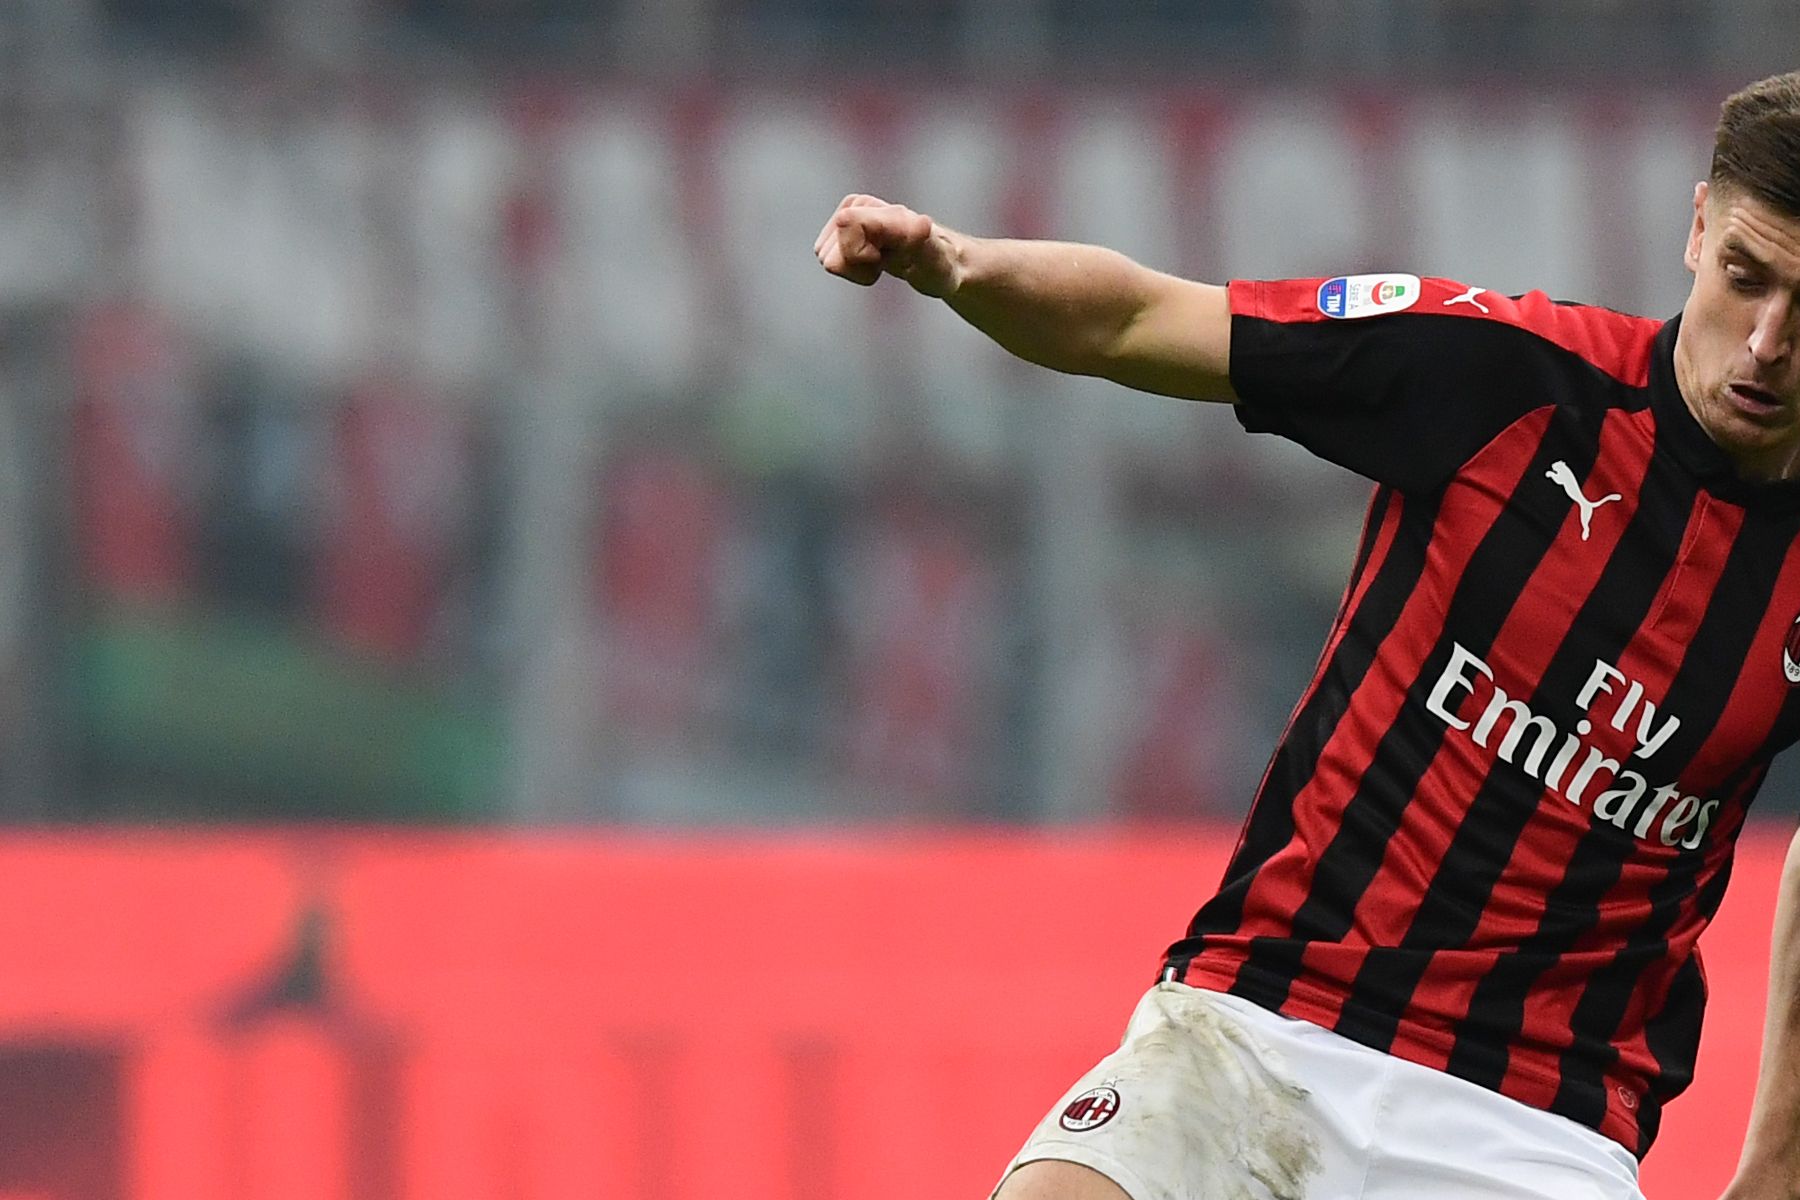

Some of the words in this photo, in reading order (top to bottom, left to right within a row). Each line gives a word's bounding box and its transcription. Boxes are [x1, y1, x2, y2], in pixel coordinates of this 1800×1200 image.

[1326, 293, 1342, 313] TIM
[1425, 641, 1719, 850] Emirates
[1575, 658, 1681, 759] Fly
